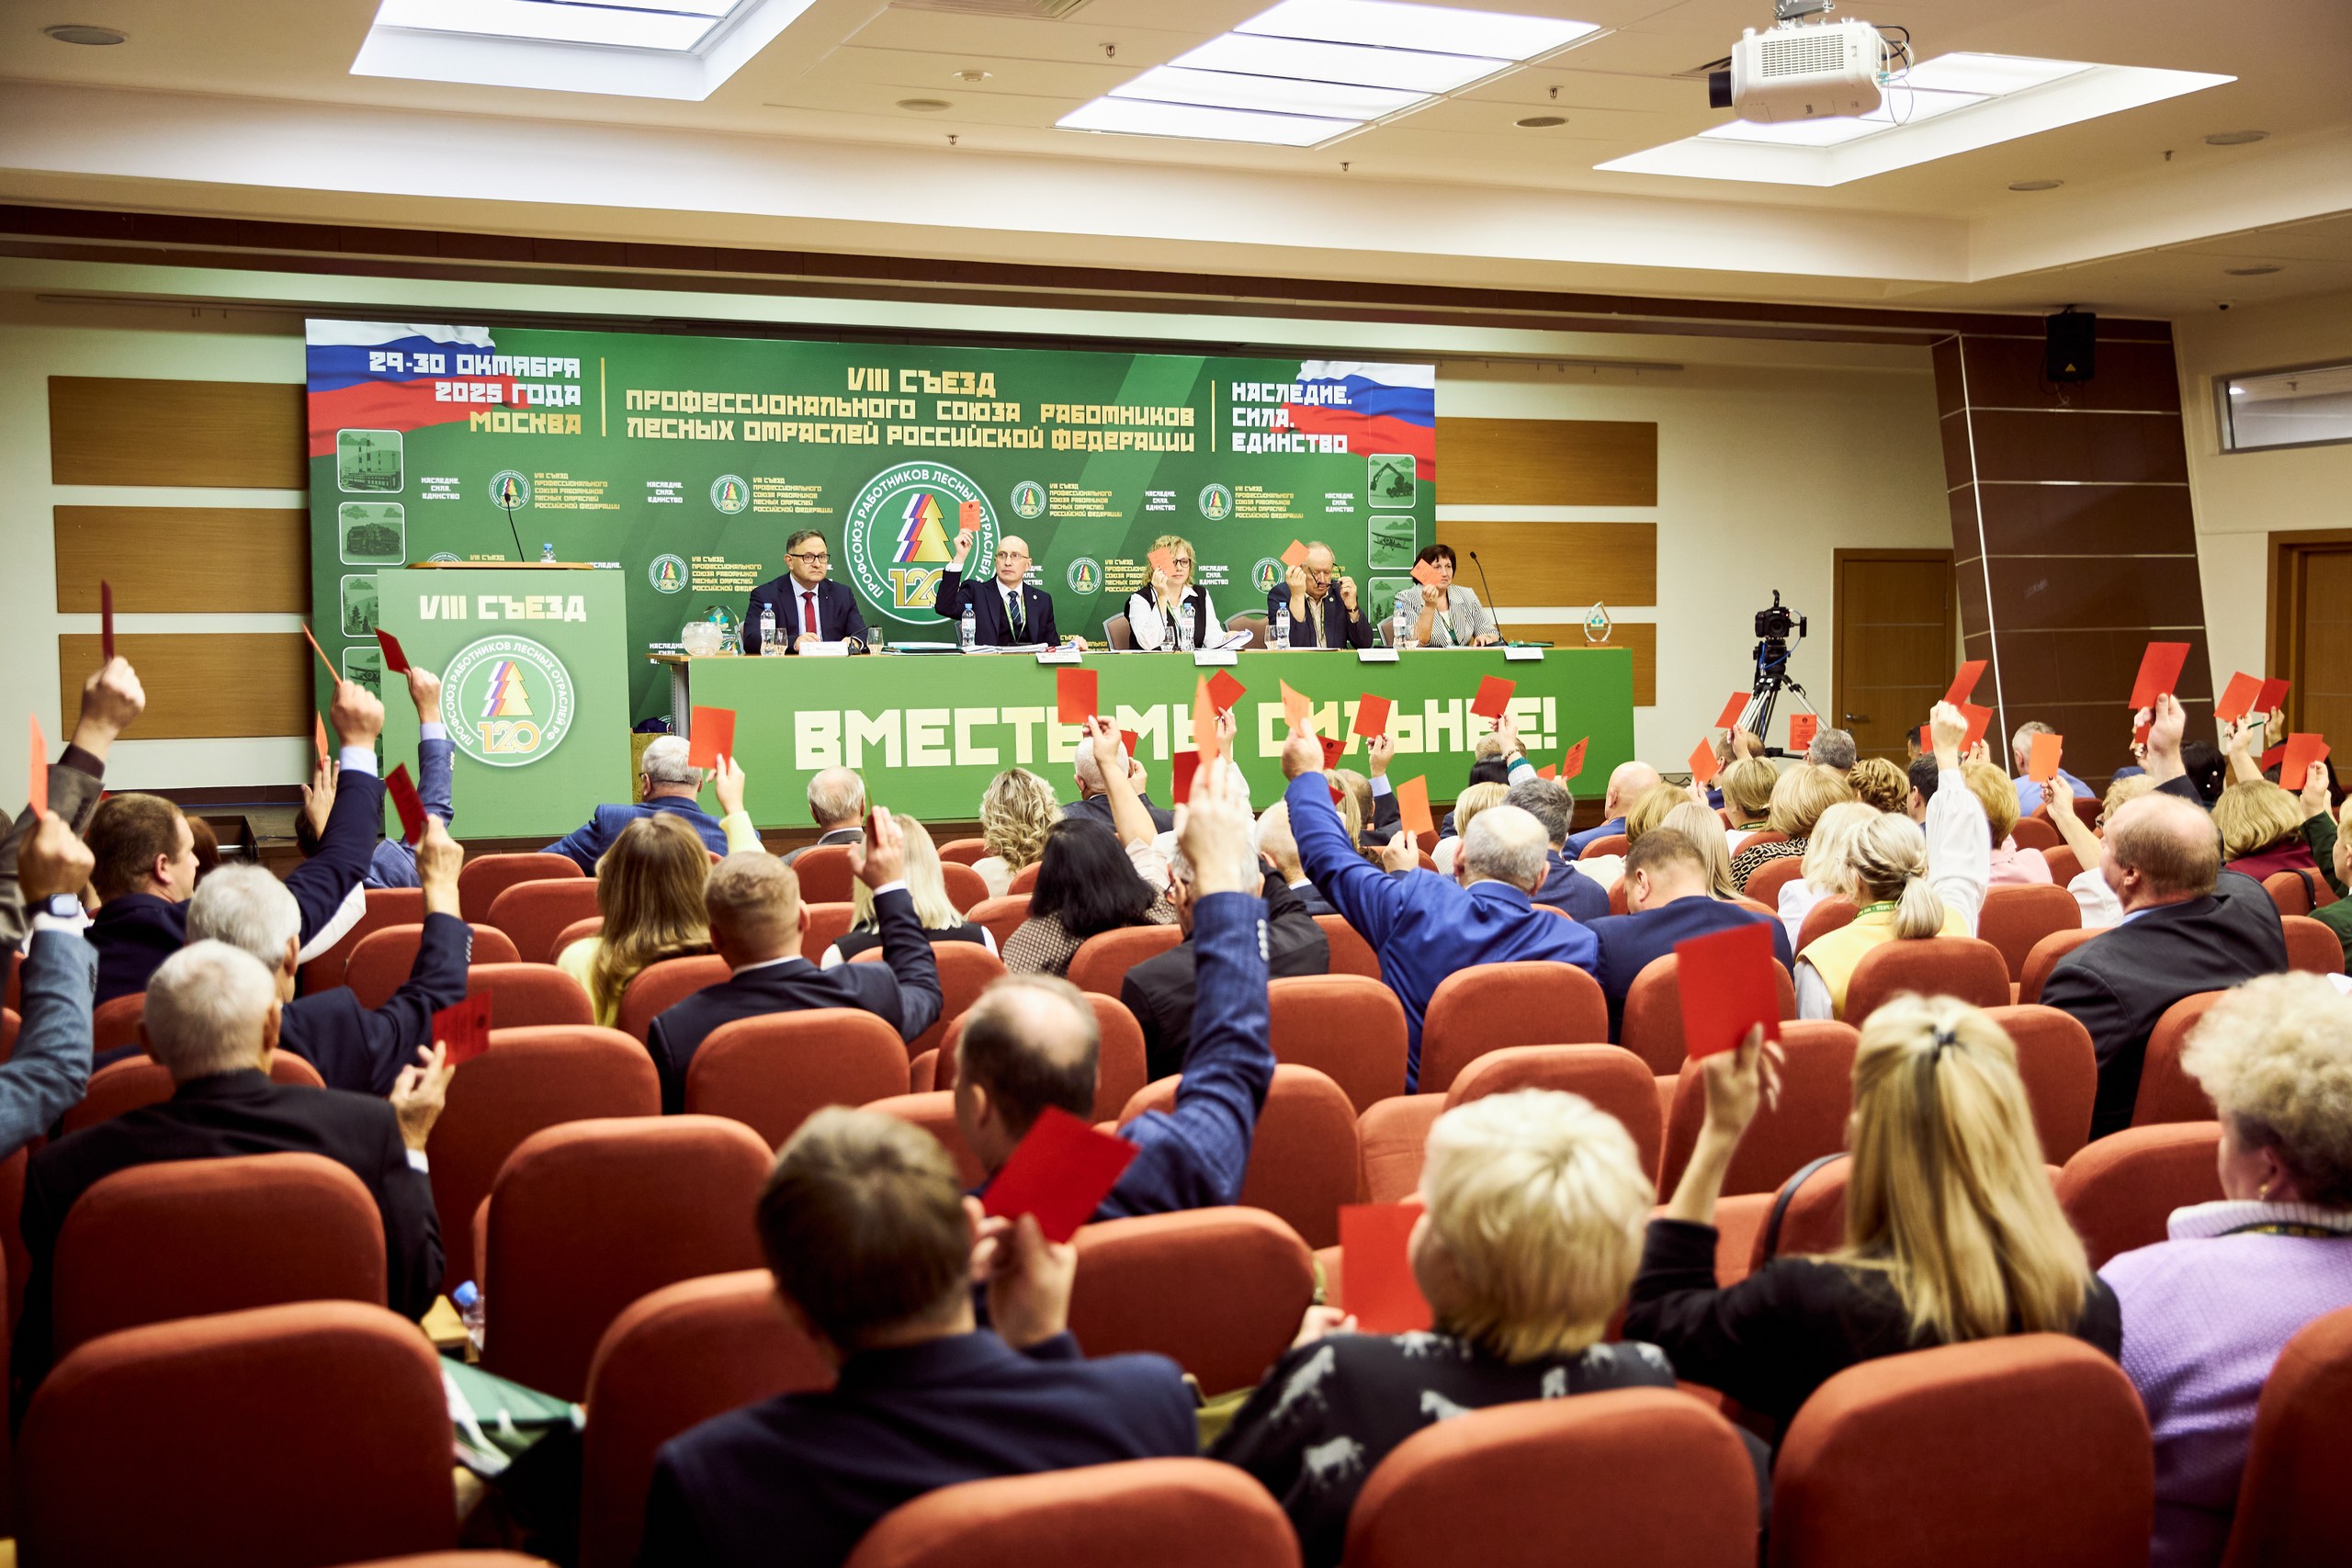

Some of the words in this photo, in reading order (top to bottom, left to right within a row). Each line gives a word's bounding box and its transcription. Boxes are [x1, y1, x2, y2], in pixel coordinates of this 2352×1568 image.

[369, 351, 446, 374] 29-30
[457, 354, 581, 378] ОКТЯБРЯ
[435, 381, 503, 403] 2025
[512, 383, 581, 407] ГОДА
[848, 367, 889, 392] VIII
[899, 369, 996, 398] СЪЕЗД
[1231, 382, 1352, 405] НАСЛЕДИЕ.
[469, 412, 581, 434] МОСКВА
[626, 389, 916, 420] ПРОФЕССИОНАЛЬНОГО
[936, 400, 1021, 423] СОЮЗА
[1040, 403, 1194, 427] РАБОТНИКОВ
[1232, 407, 1295, 428] СИЛА.
[627, 417, 735, 441] ЛЕСНЫХ
[743, 421, 879, 446] ОТРАСЛЕЙ
[887, 423, 1044, 449] РОССИЙСКОЙ
[1051, 428, 1194, 452] ФЕДЕРАЦИИ
[1232, 432, 1348, 454] ЕДИНСТВО
[857, 469, 930, 519] РАБОТНИКОВ
[852, 517, 885, 599] ПРОФСОЮЗ
[420, 595, 467, 620] VIII
[478, 595, 587, 622] СЪЕЗД
[449, 641, 512, 683] РАБОТНИКОВ
[513, 642, 555, 671] ЛЕСНЫХ
[551, 669, 569, 727] ОТРАСЛЕЙ
[446, 683, 474, 747] ПРОФСОЮЗ
[477, 720, 542, 753] 120
[547, 728, 560, 740] РФ
